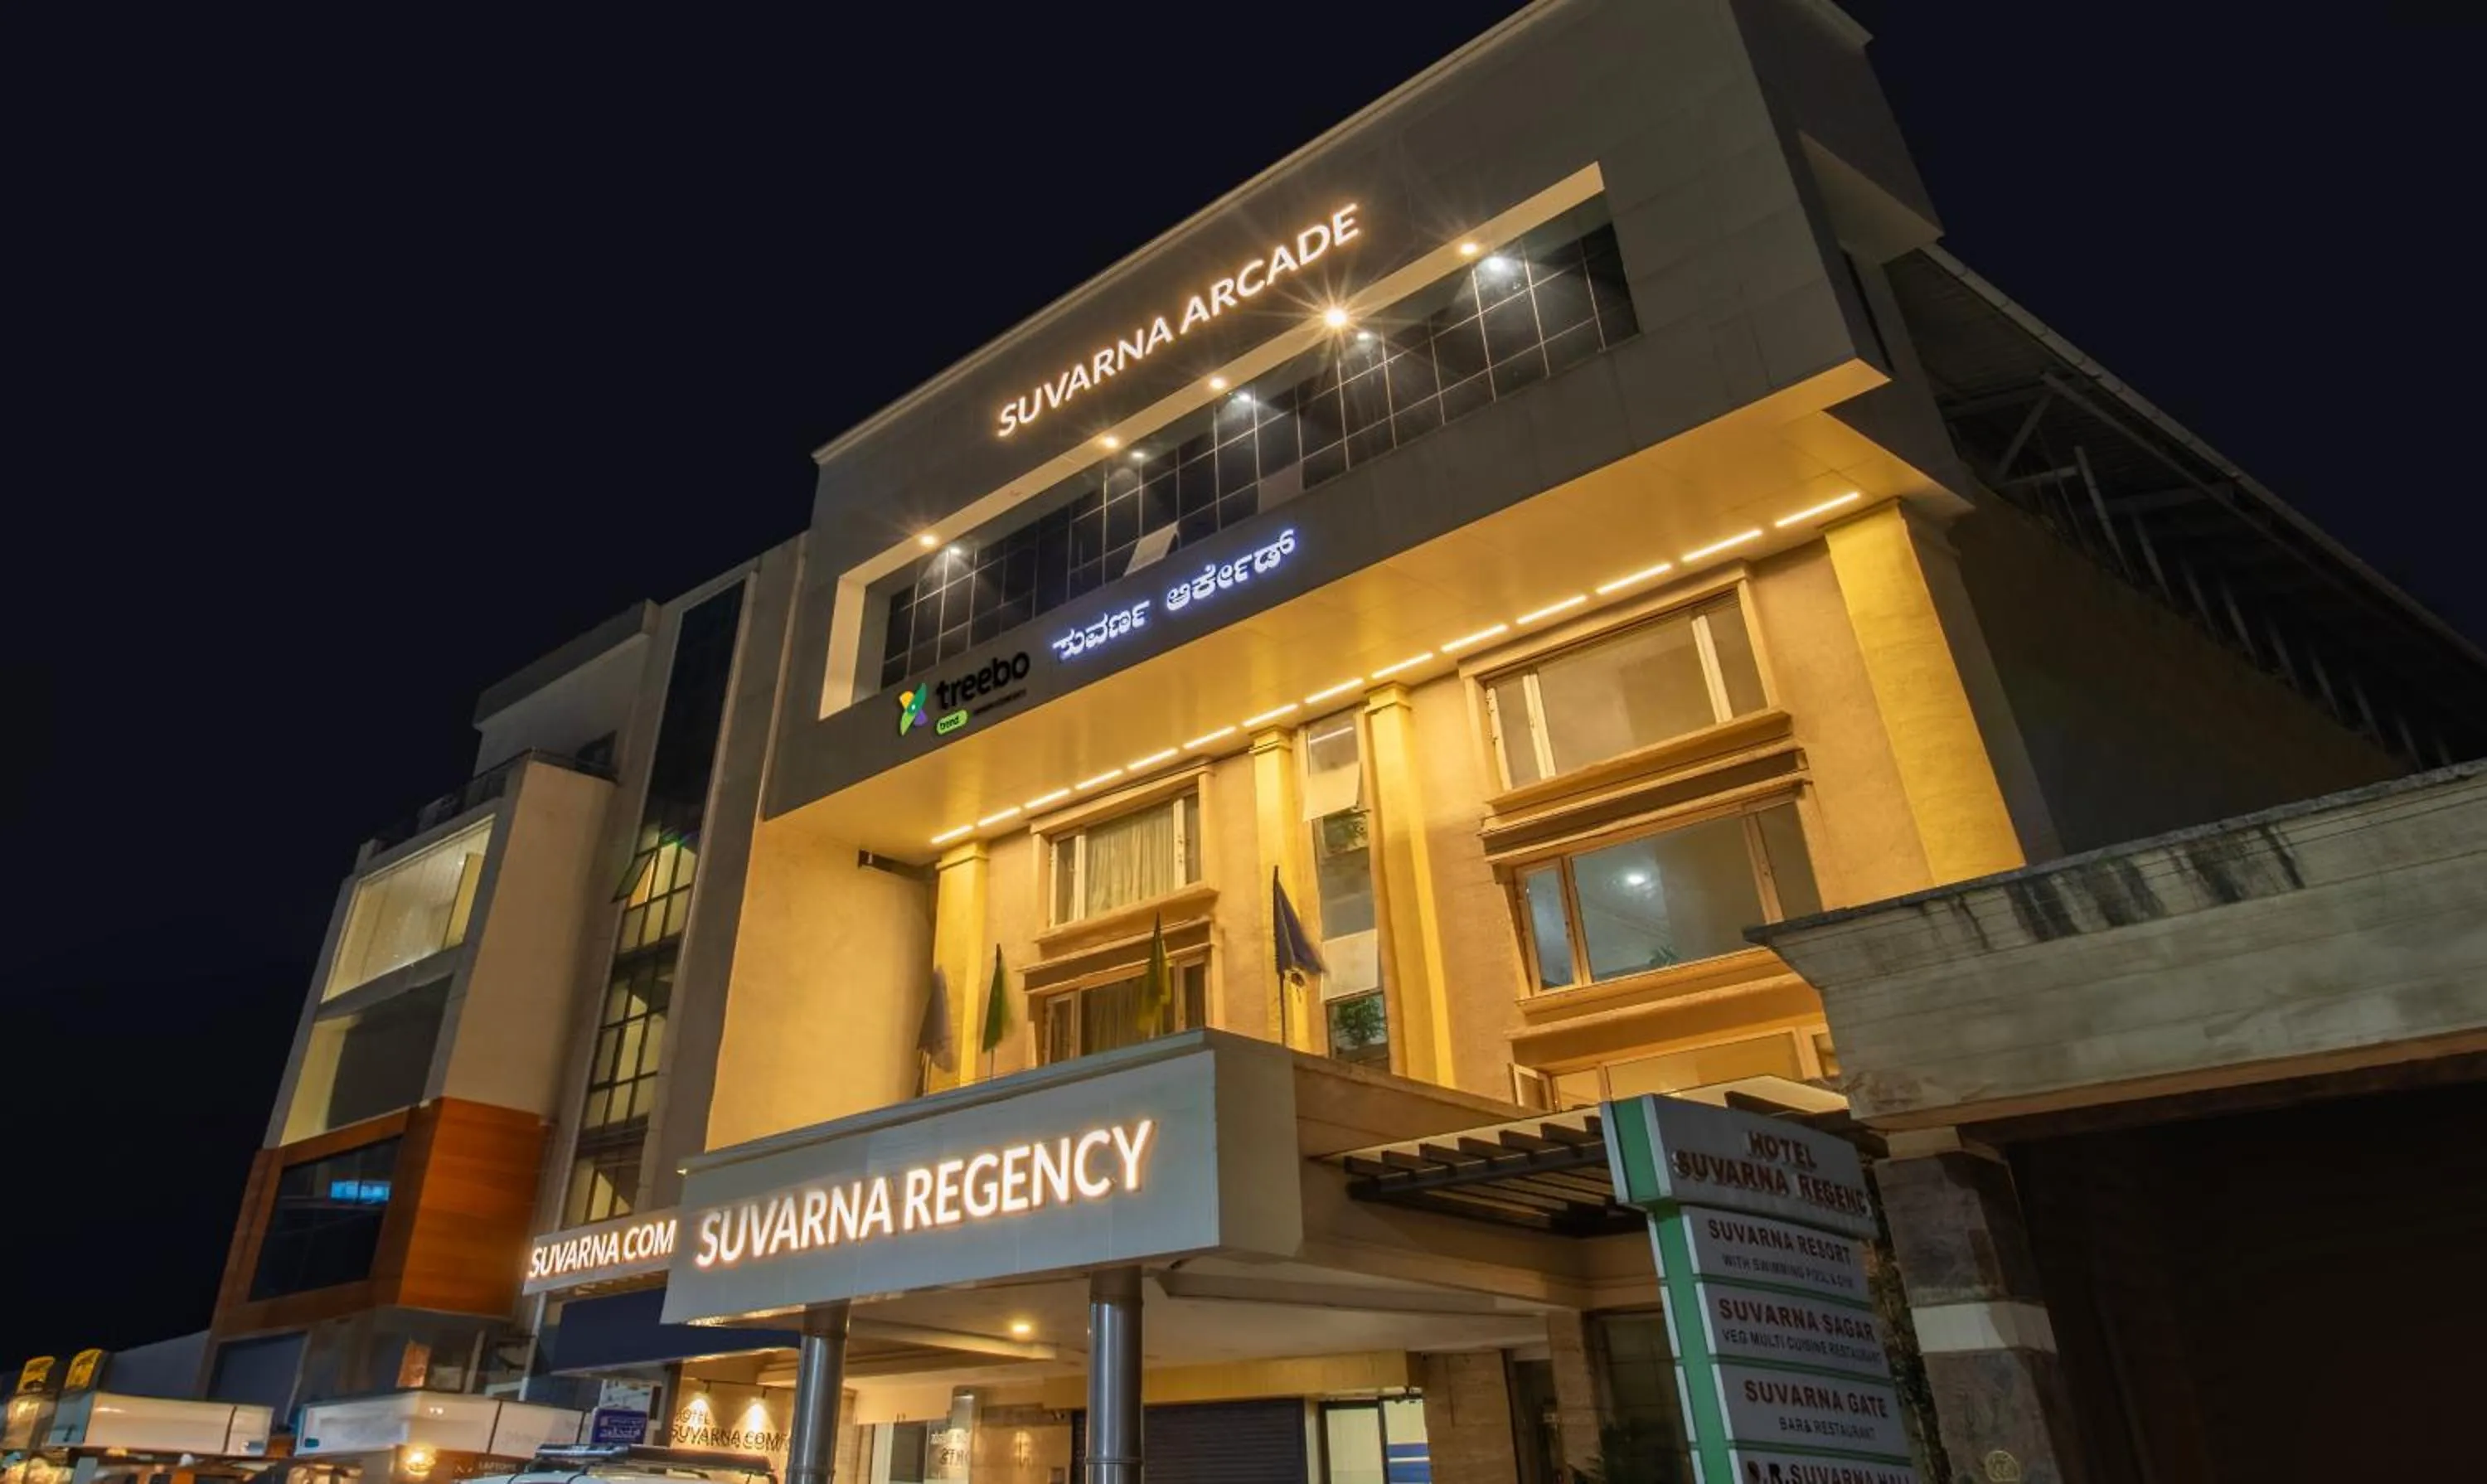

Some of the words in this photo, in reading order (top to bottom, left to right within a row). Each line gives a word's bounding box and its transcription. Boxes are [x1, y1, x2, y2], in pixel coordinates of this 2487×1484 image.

[998, 317, 1174, 438] SUVARNA
[1180, 203, 1360, 333] ARCADE
[1052, 599, 1151, 661] ಸುವರ್ಣ
[936, 650, 1030, 710] treebo
[939, 715, 960, 731] trend
[1746, 1130, 1817, 1170] HOTEL
[695, 1177, 894, 1268] SUVARNA
[904, 1120, 1155, 1231] REGENCY
[1672, 1149, 1789, 1197] SUVARNA
[1793, 1171, 1873, 1218] REGENC
[528, 1231, 620, 1278] SUVARNA
[1709, 1218, 1794, 1254] SUVARNA
[1797, 1234, 1851, 1267] RESORT
[1723, 1254, 1750, 1270] WITH
[1719, 1297, 1820, 1333] SUVARNA
[1823, 1315, 1876, 1343] SAGAR
[1722, 1329, 1748, 1344] VEG
[1750, 1331, 1785, 1350] MULTI
[1745, 1380, 1842, 1410] SUVARNA
[1847, 1389, 1889, 1419] GATE
[671, 1425, 740, 1448] SUVARNA
